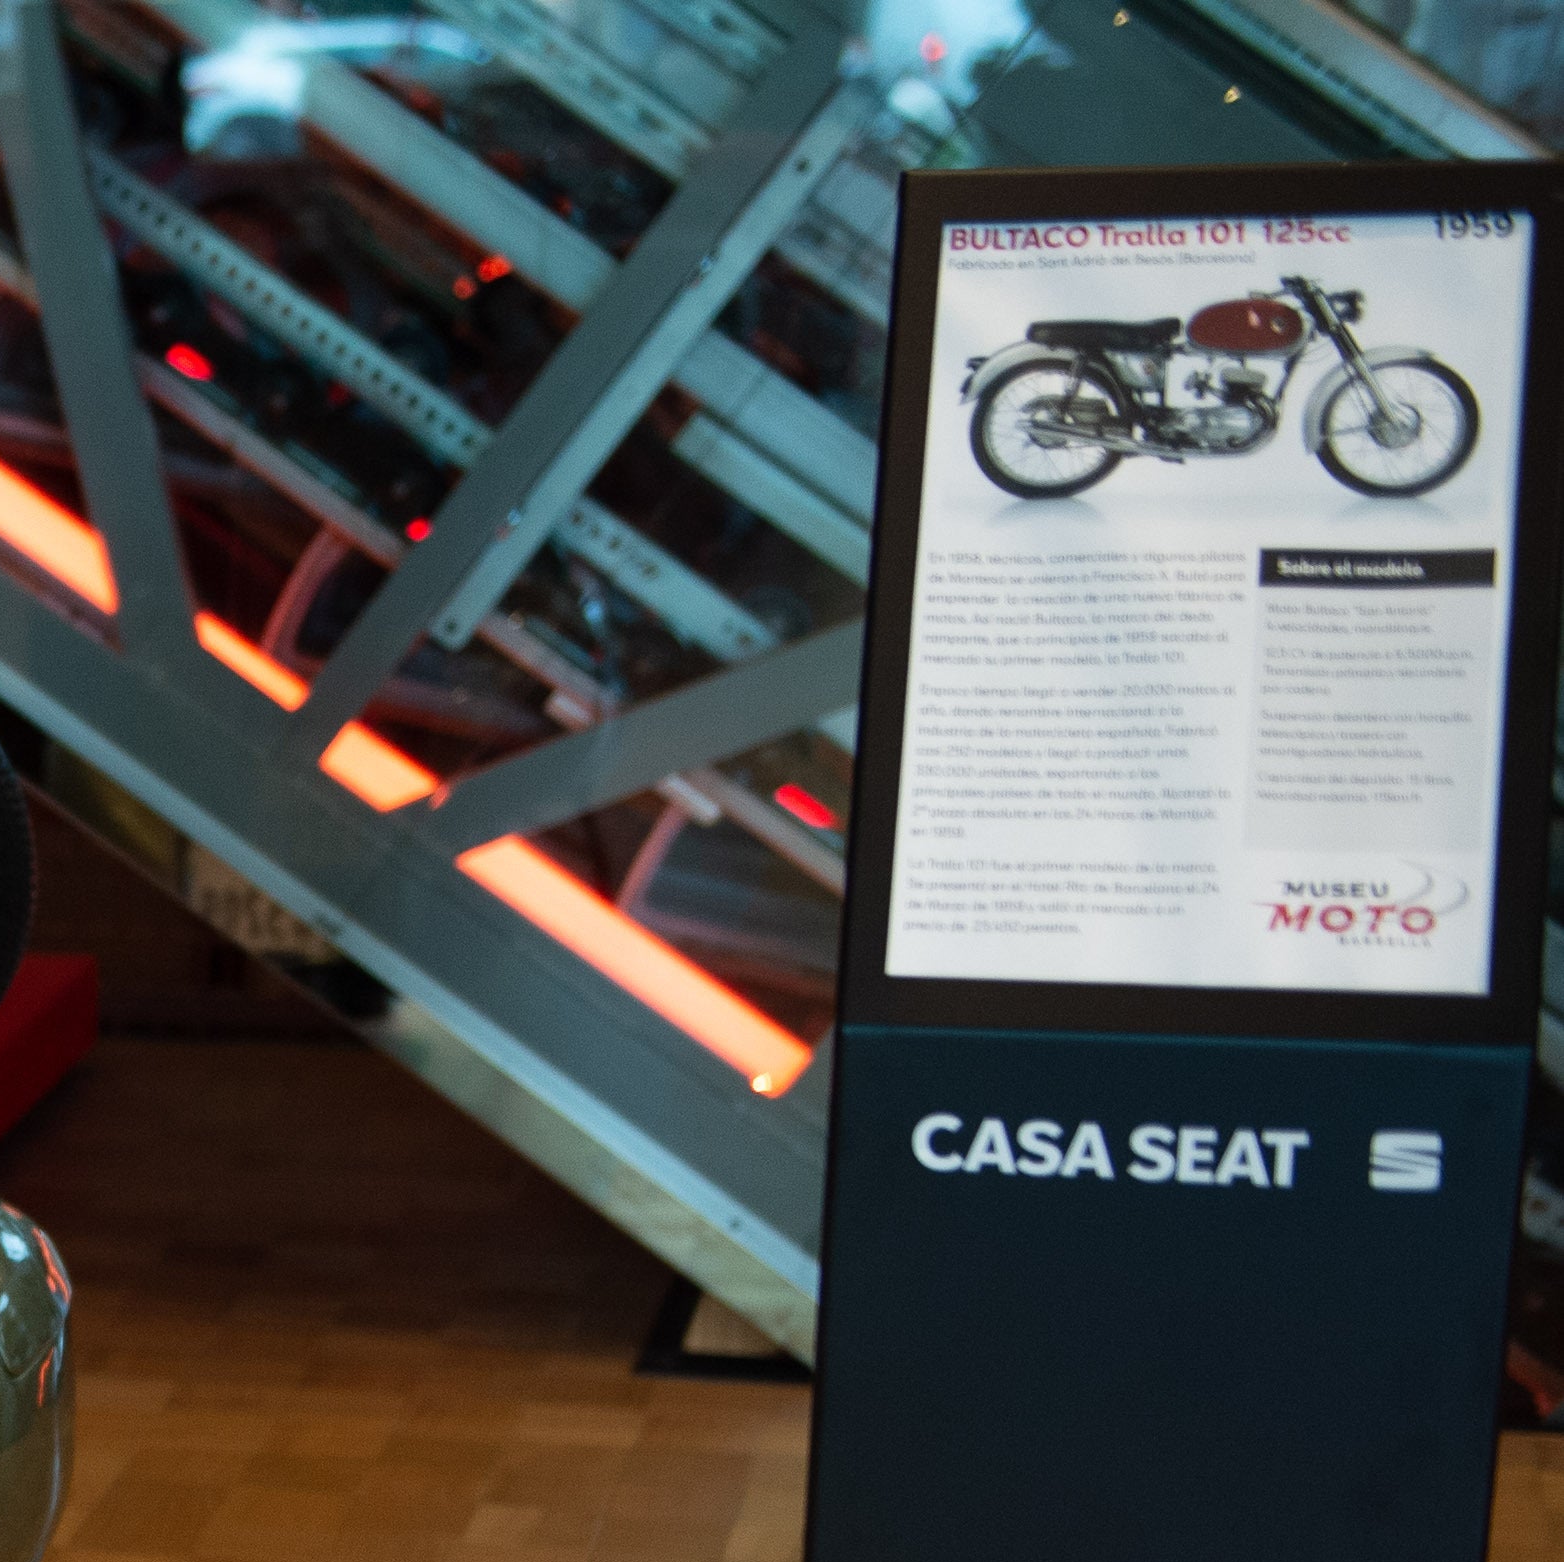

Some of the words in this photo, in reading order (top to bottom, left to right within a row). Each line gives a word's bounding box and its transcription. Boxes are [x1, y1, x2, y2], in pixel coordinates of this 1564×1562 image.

[950, 224, 1089, 250] BULTACO
[1097, 223, 1186, 246] Tralla
[1195, 221, 1245, 245] 101
[1263, 219, 1352, 243] 125cc
[1436, 212, 1515, 239] 1959
[1281, 880, 1389, 898] MUSEU
[1262, 904, 1437, 935] MOTO
[911, 1112, 1115, 1180] CASA
[1127, 1124, 1310, 1188] SEAT
